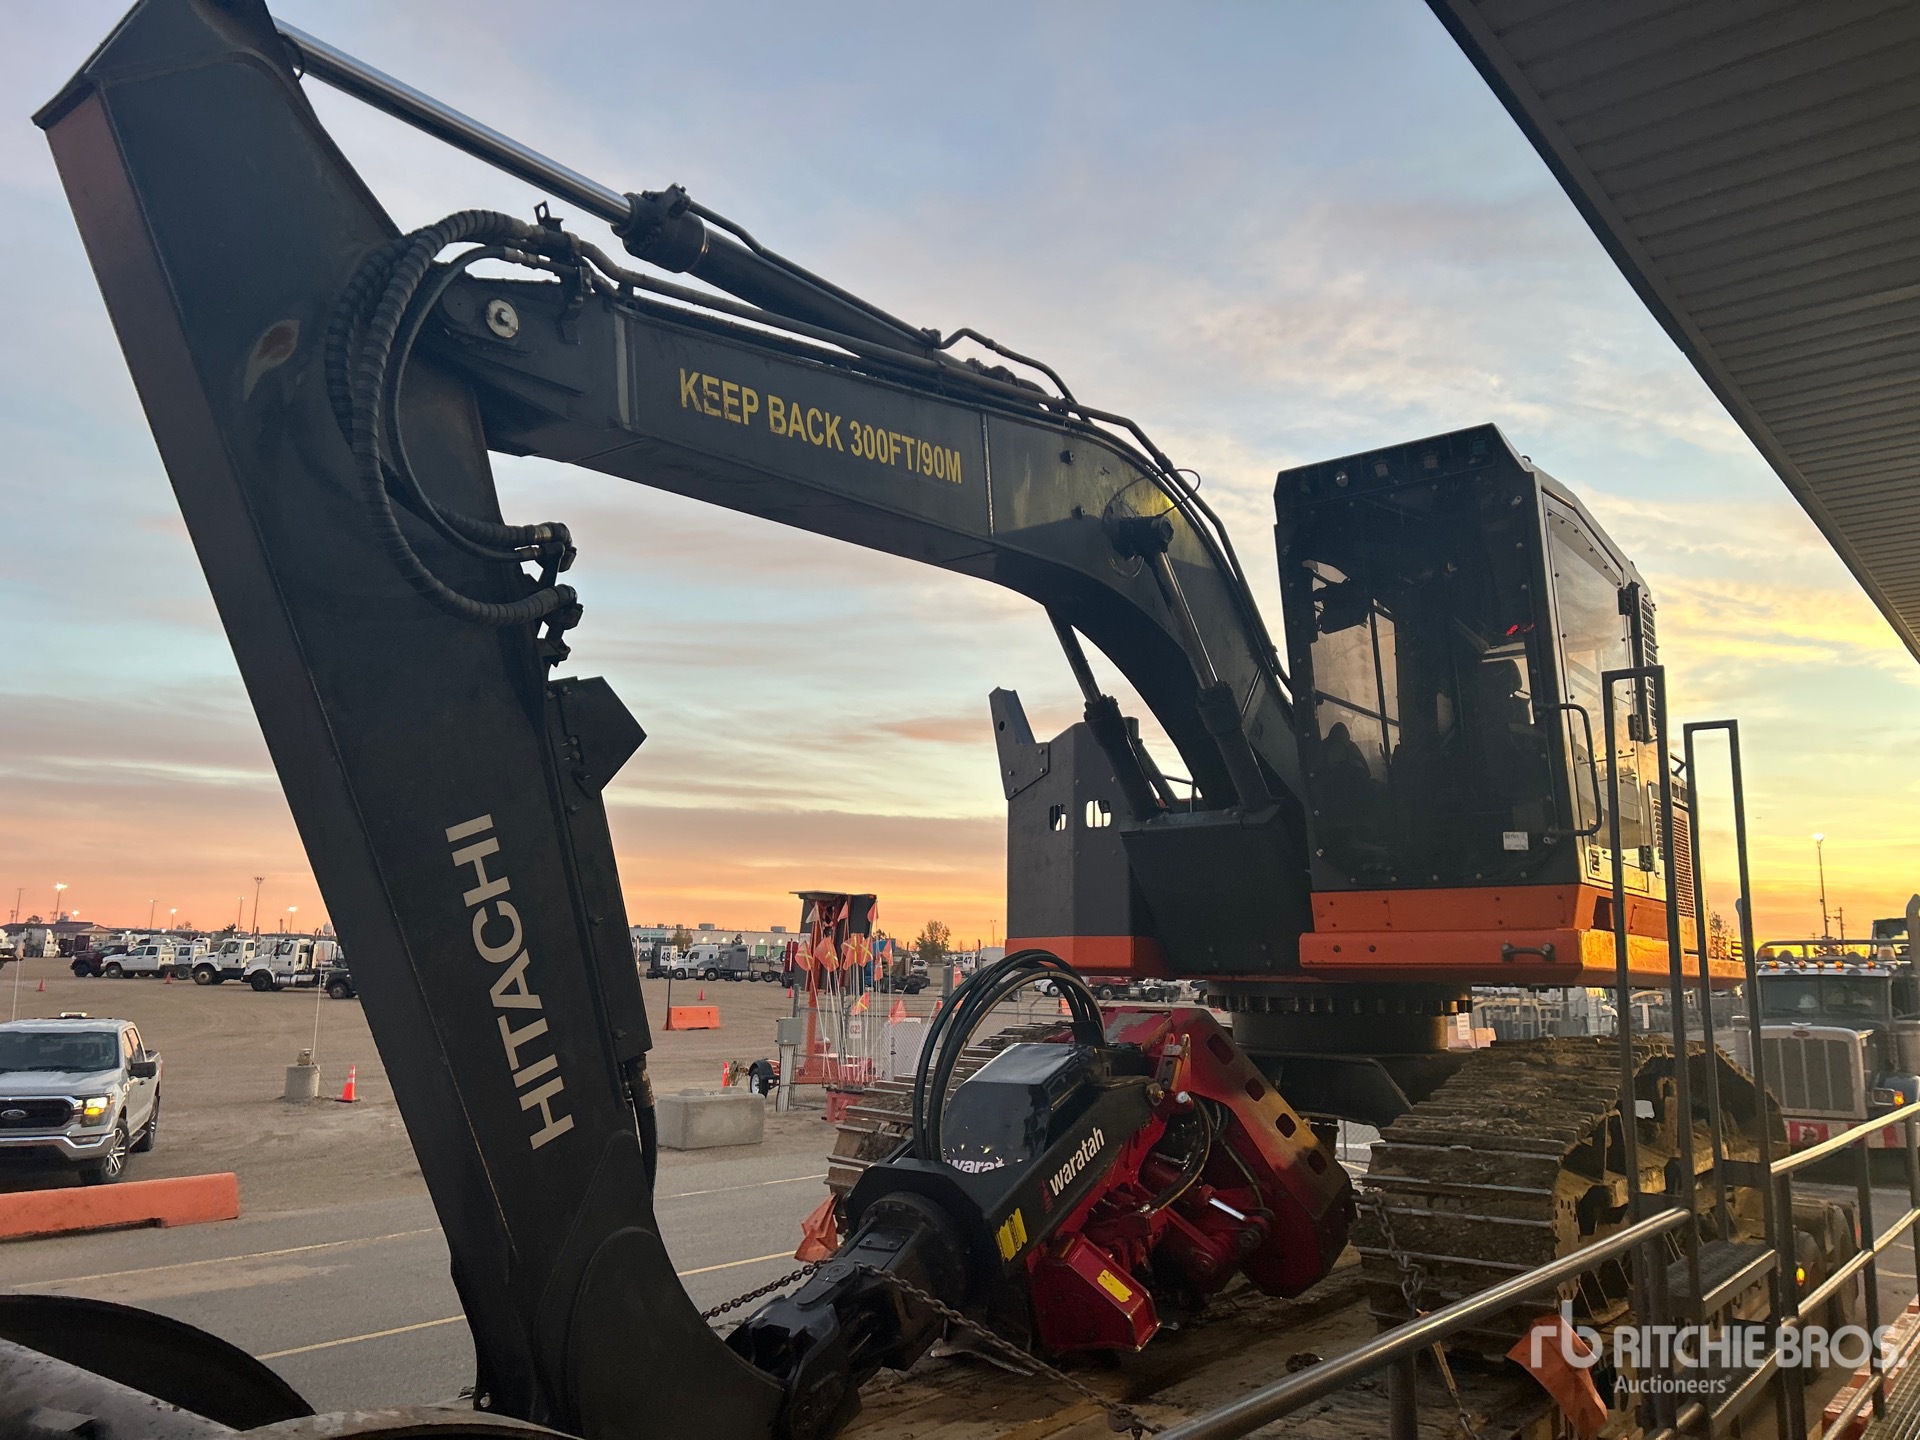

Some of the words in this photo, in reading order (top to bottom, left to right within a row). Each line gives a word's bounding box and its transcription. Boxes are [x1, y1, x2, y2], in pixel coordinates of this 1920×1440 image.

[679, 367, 760, 426] KEEP
[767, 394, 844, 452] BACK
[850, 420, 962, 484] 300FT/90M
[445, 813, 575, 1151] HITACHI
[1049, 1126, 1105, 1197] waratah
